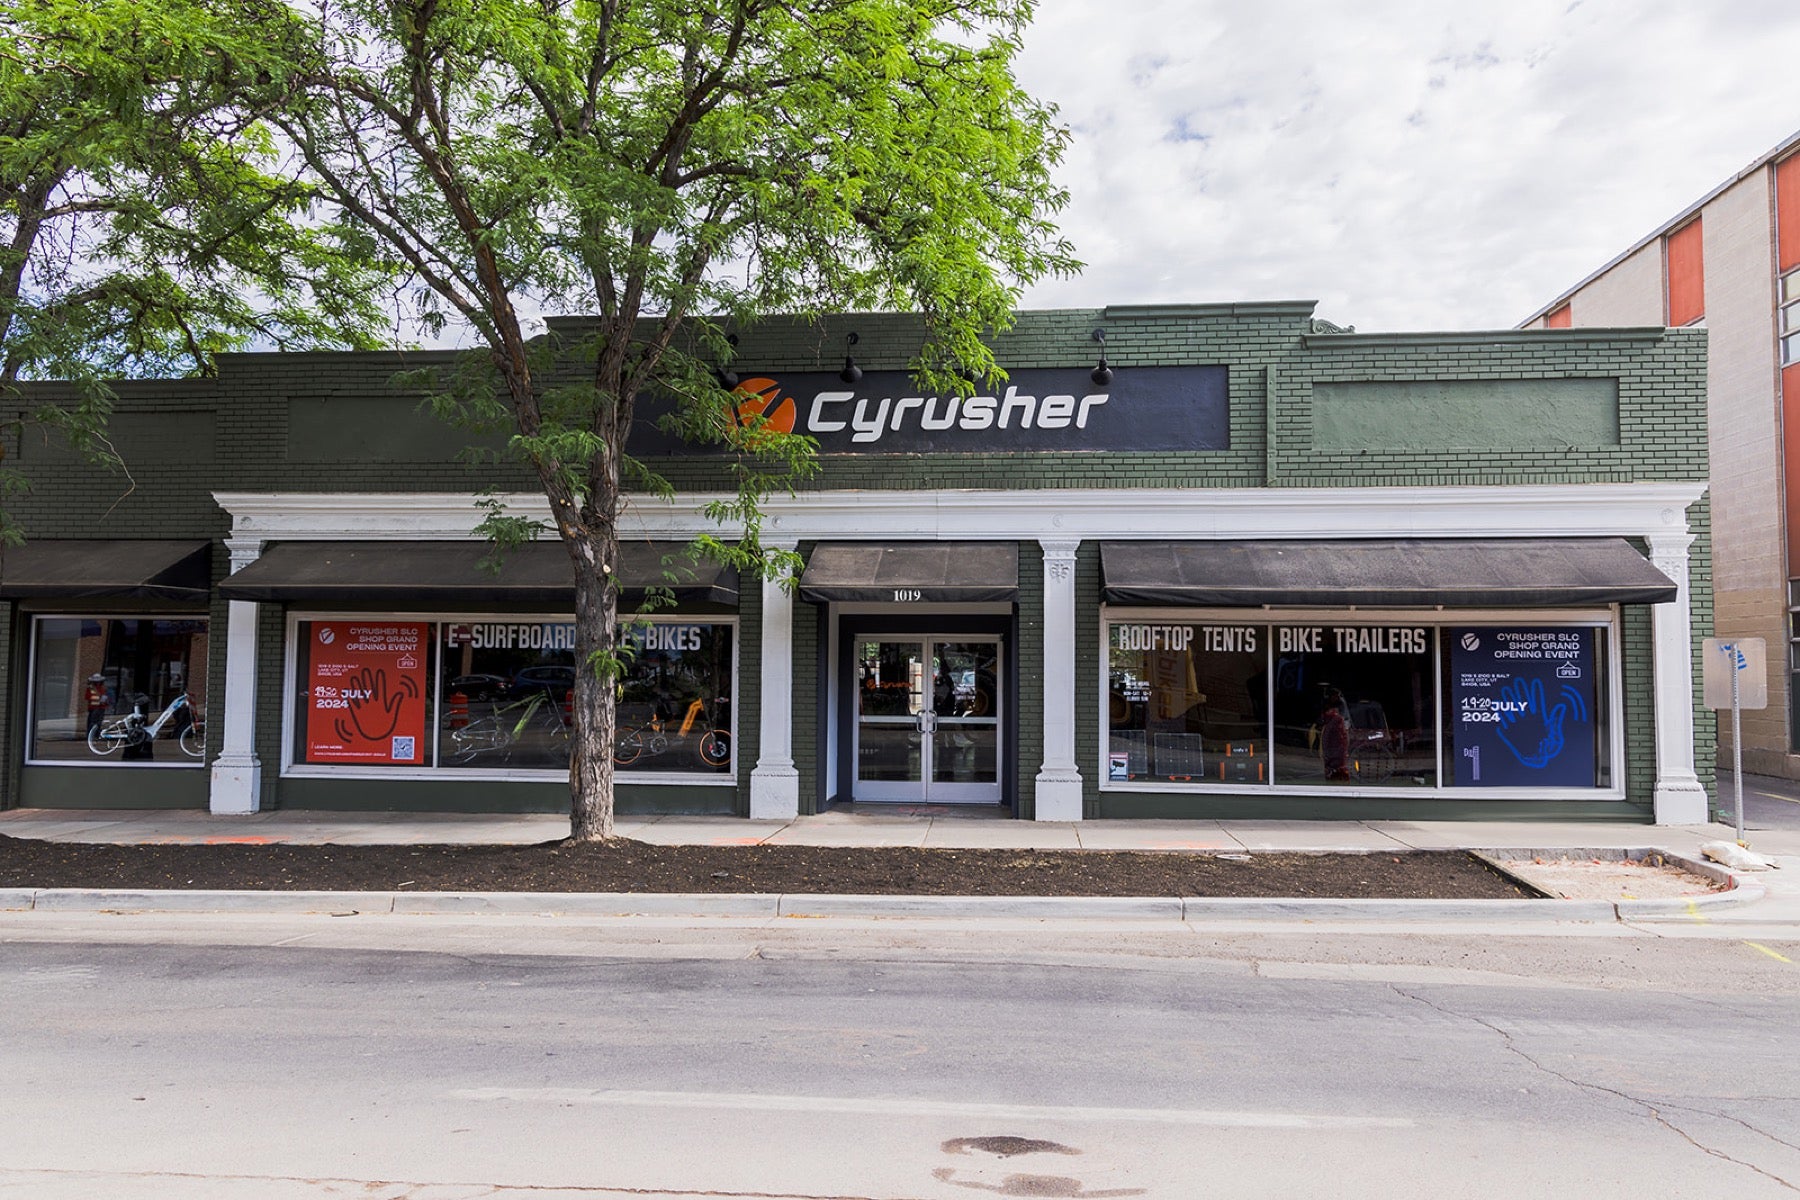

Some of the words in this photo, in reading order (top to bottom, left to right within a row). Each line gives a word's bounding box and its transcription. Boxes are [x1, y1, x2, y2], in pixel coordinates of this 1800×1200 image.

[807, 386, 1109, 442] Cyrusher
[894, 590, 921, 601] 1019
[621, 624, 701, 650] E-BIKES
[1120, 625, 1194, 651] ROOFTOP
[1203, 627, 1256, 653] TENTS
[1279, 627, 1323, 652] BIKE
[1333, 628, 1426, 653] TRAILERS
[1497, 633, 1556, 641] CYRUSHER
[1558, 633, 1580, 641] SLC
[346, 643, 386, 651] OPENING
[1541, 642, 1580, 650] GRAND
[1494, 650, 1541, 658] OPENING
[1545, 651, 1580, 659] EVENT
[341, 690, 371, 699] JULY
[316, 699, 349, 709] 2024
[1461, 696, 1491, 709] 19-20
[1491, 701, 1528, 711] JULY
[1462, 712, 1501, 722] 2024
